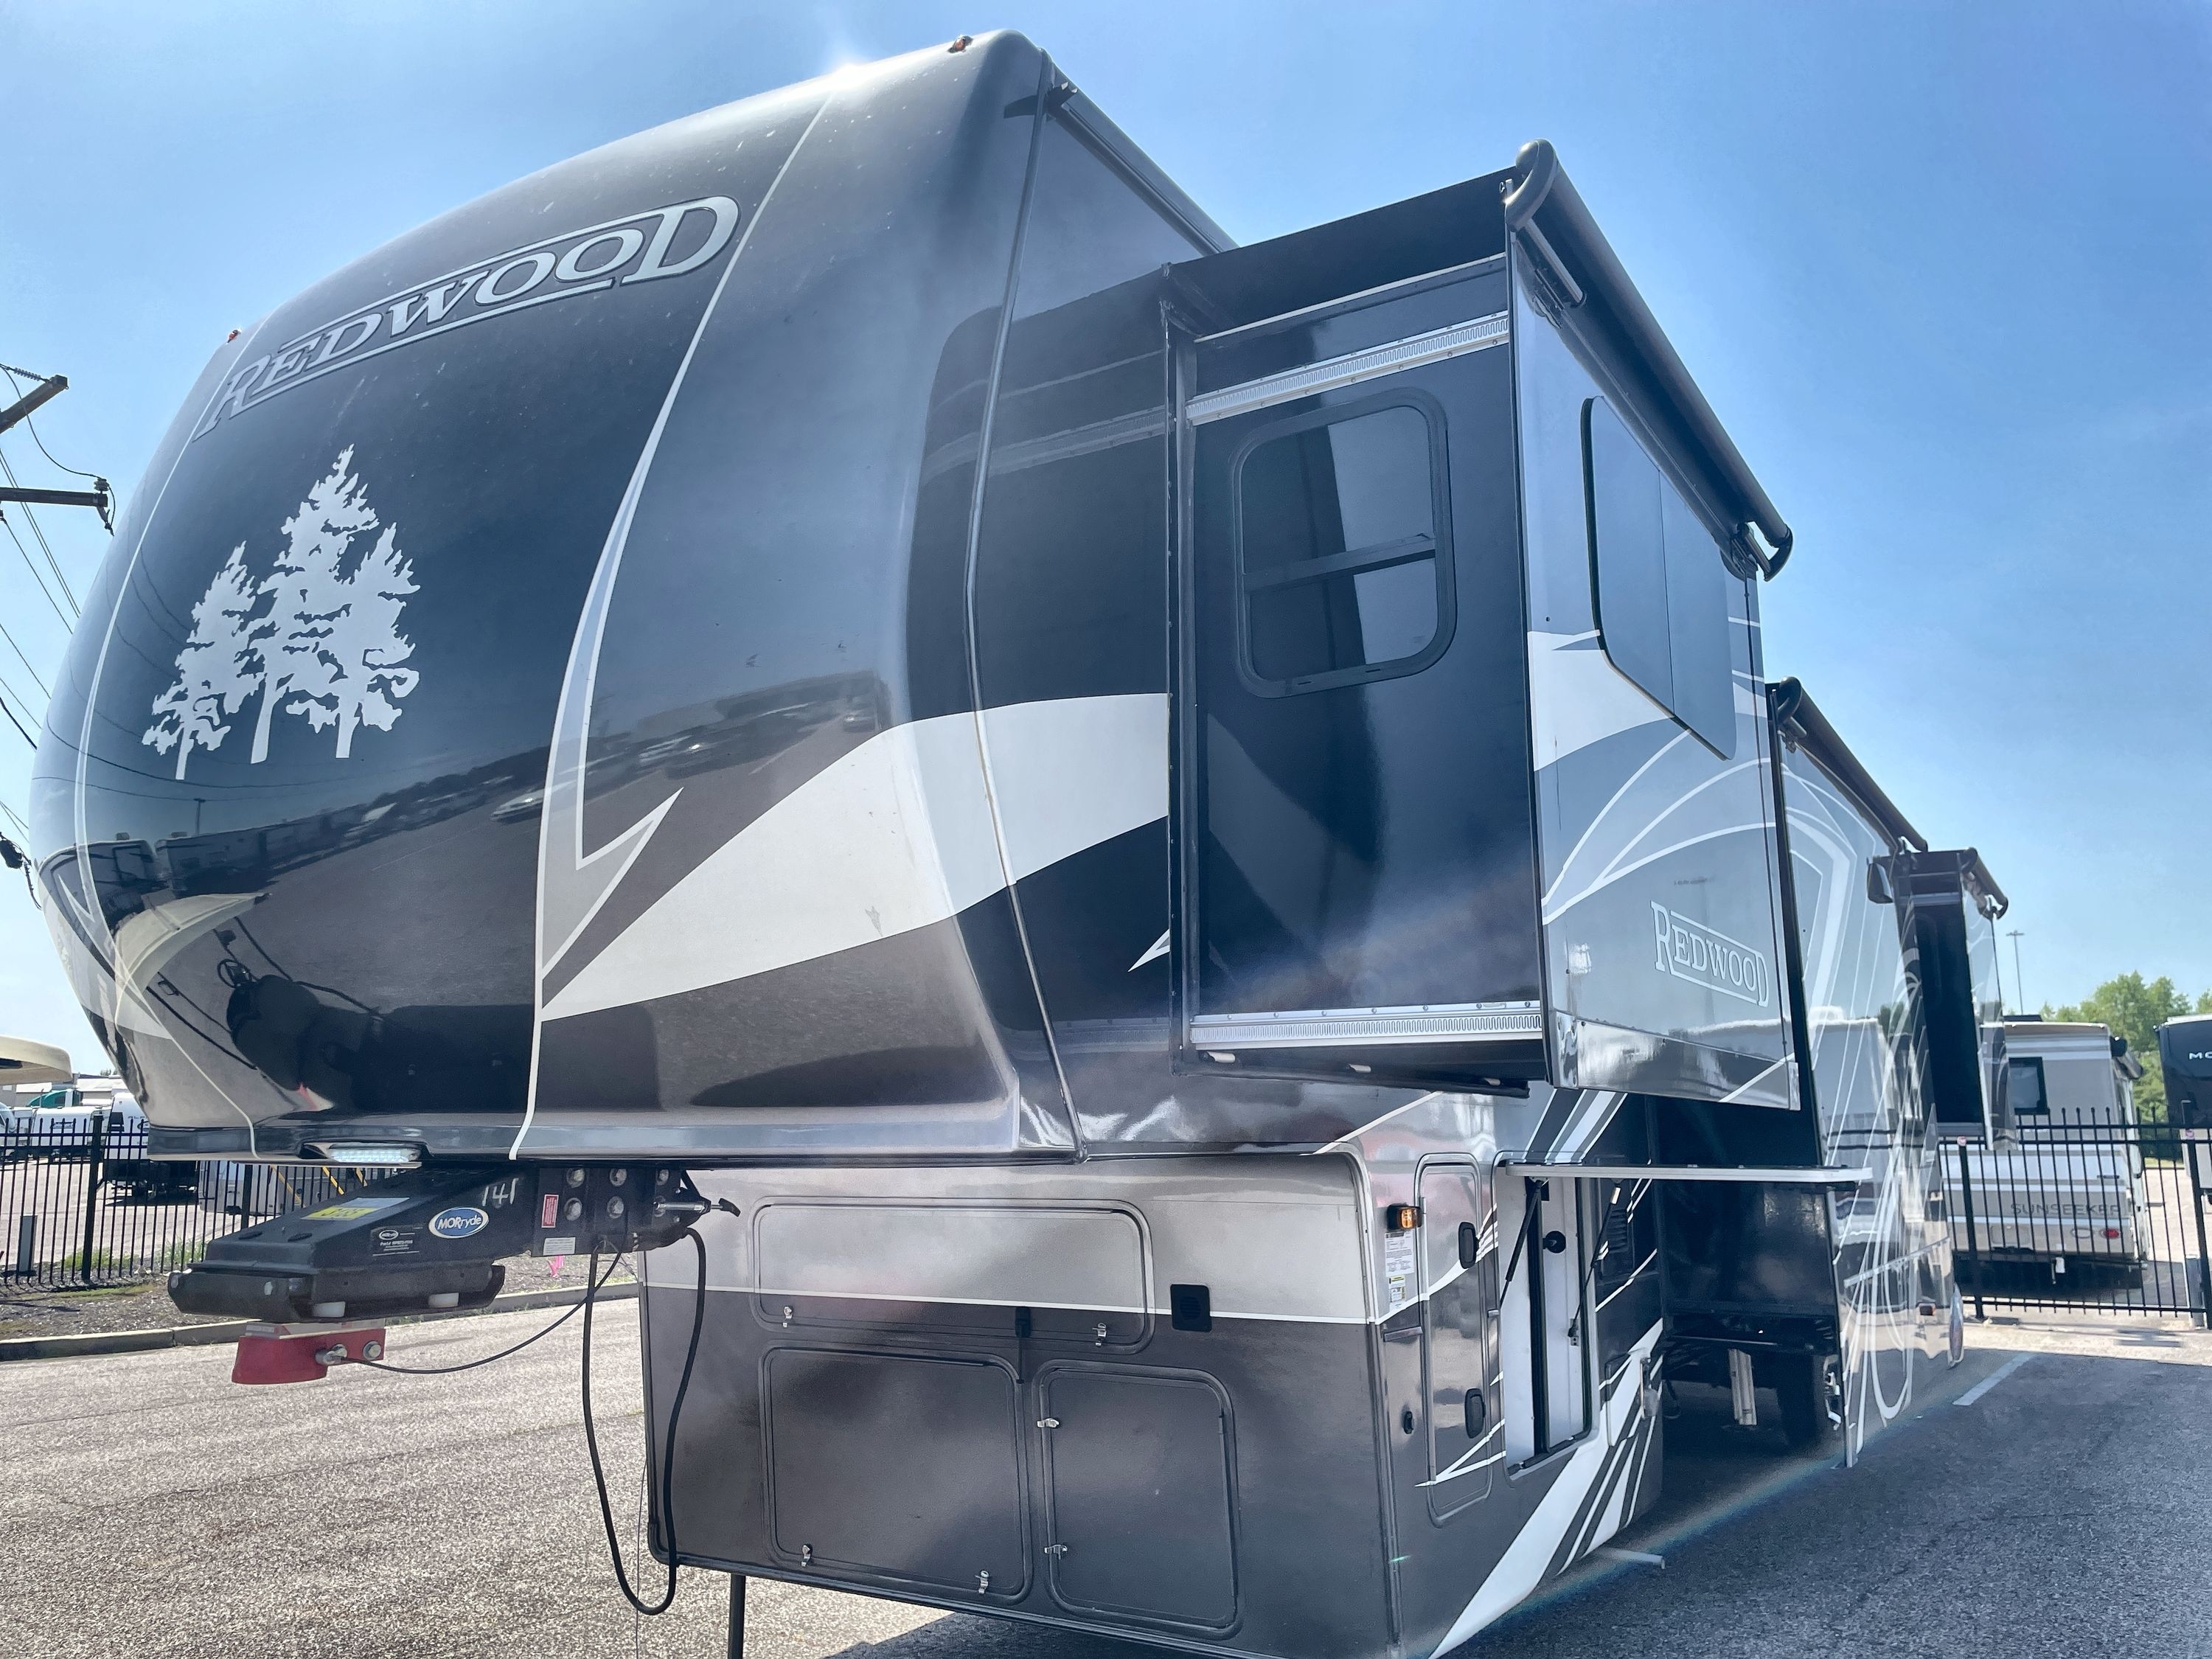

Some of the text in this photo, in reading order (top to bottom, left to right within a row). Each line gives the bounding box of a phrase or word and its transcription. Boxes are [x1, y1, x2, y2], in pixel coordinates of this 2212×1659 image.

[192, 195, 741, 442] REDWOOD
[1650, 900, 1770, 1008] REDWOOD
[437, 1214, 482, 1230] MORryde
[481, 1178, 519, 1206] 141
